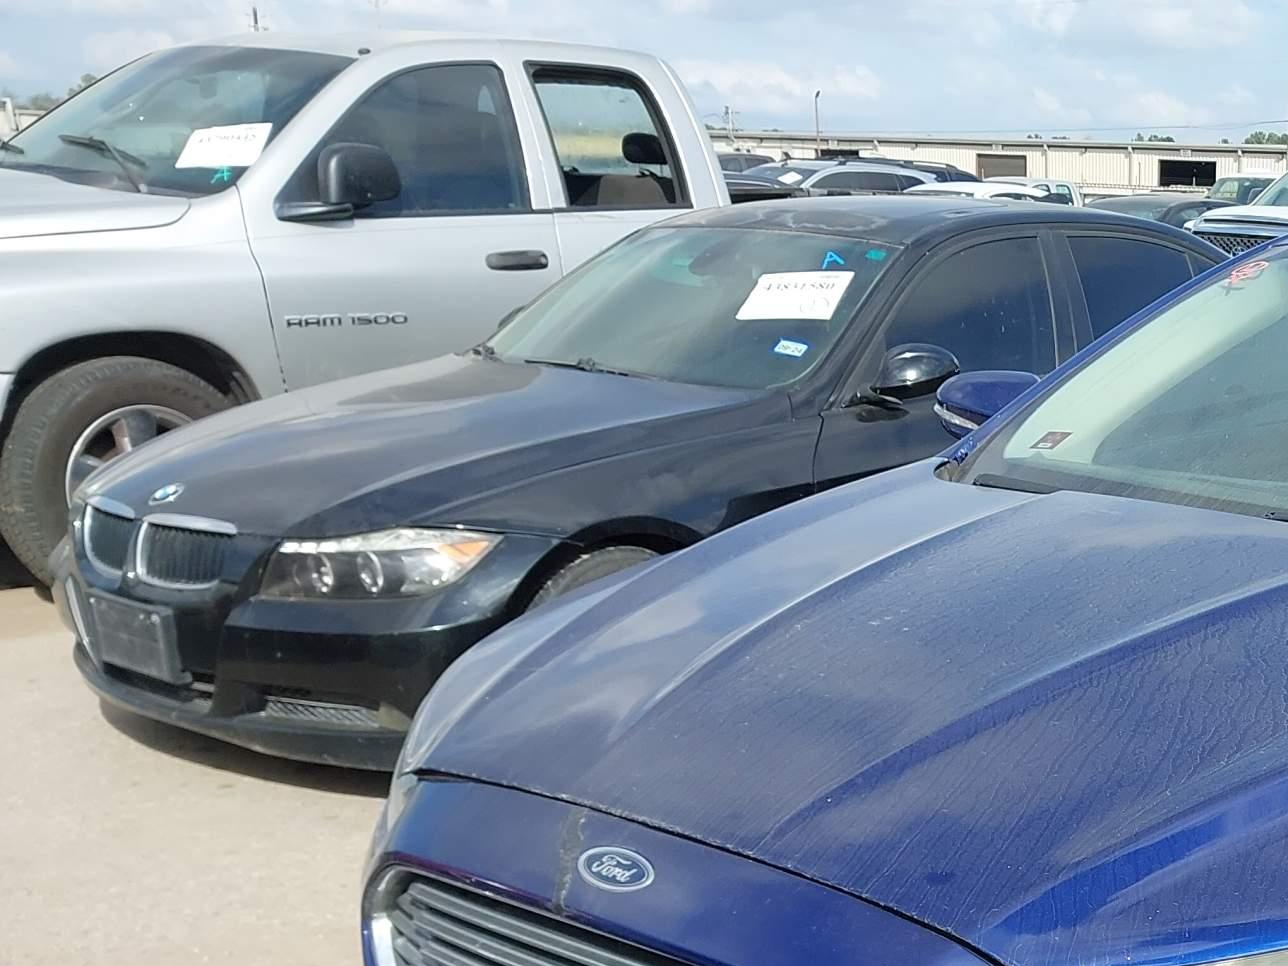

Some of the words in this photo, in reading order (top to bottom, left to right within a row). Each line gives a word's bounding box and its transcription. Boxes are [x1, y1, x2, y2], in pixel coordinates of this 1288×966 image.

[822, 251, 845, 269] A
[284, 314, 342, 328] RAM
[347, 312, 408, 326] 1500
[591, 854, 638, 882] Ford
